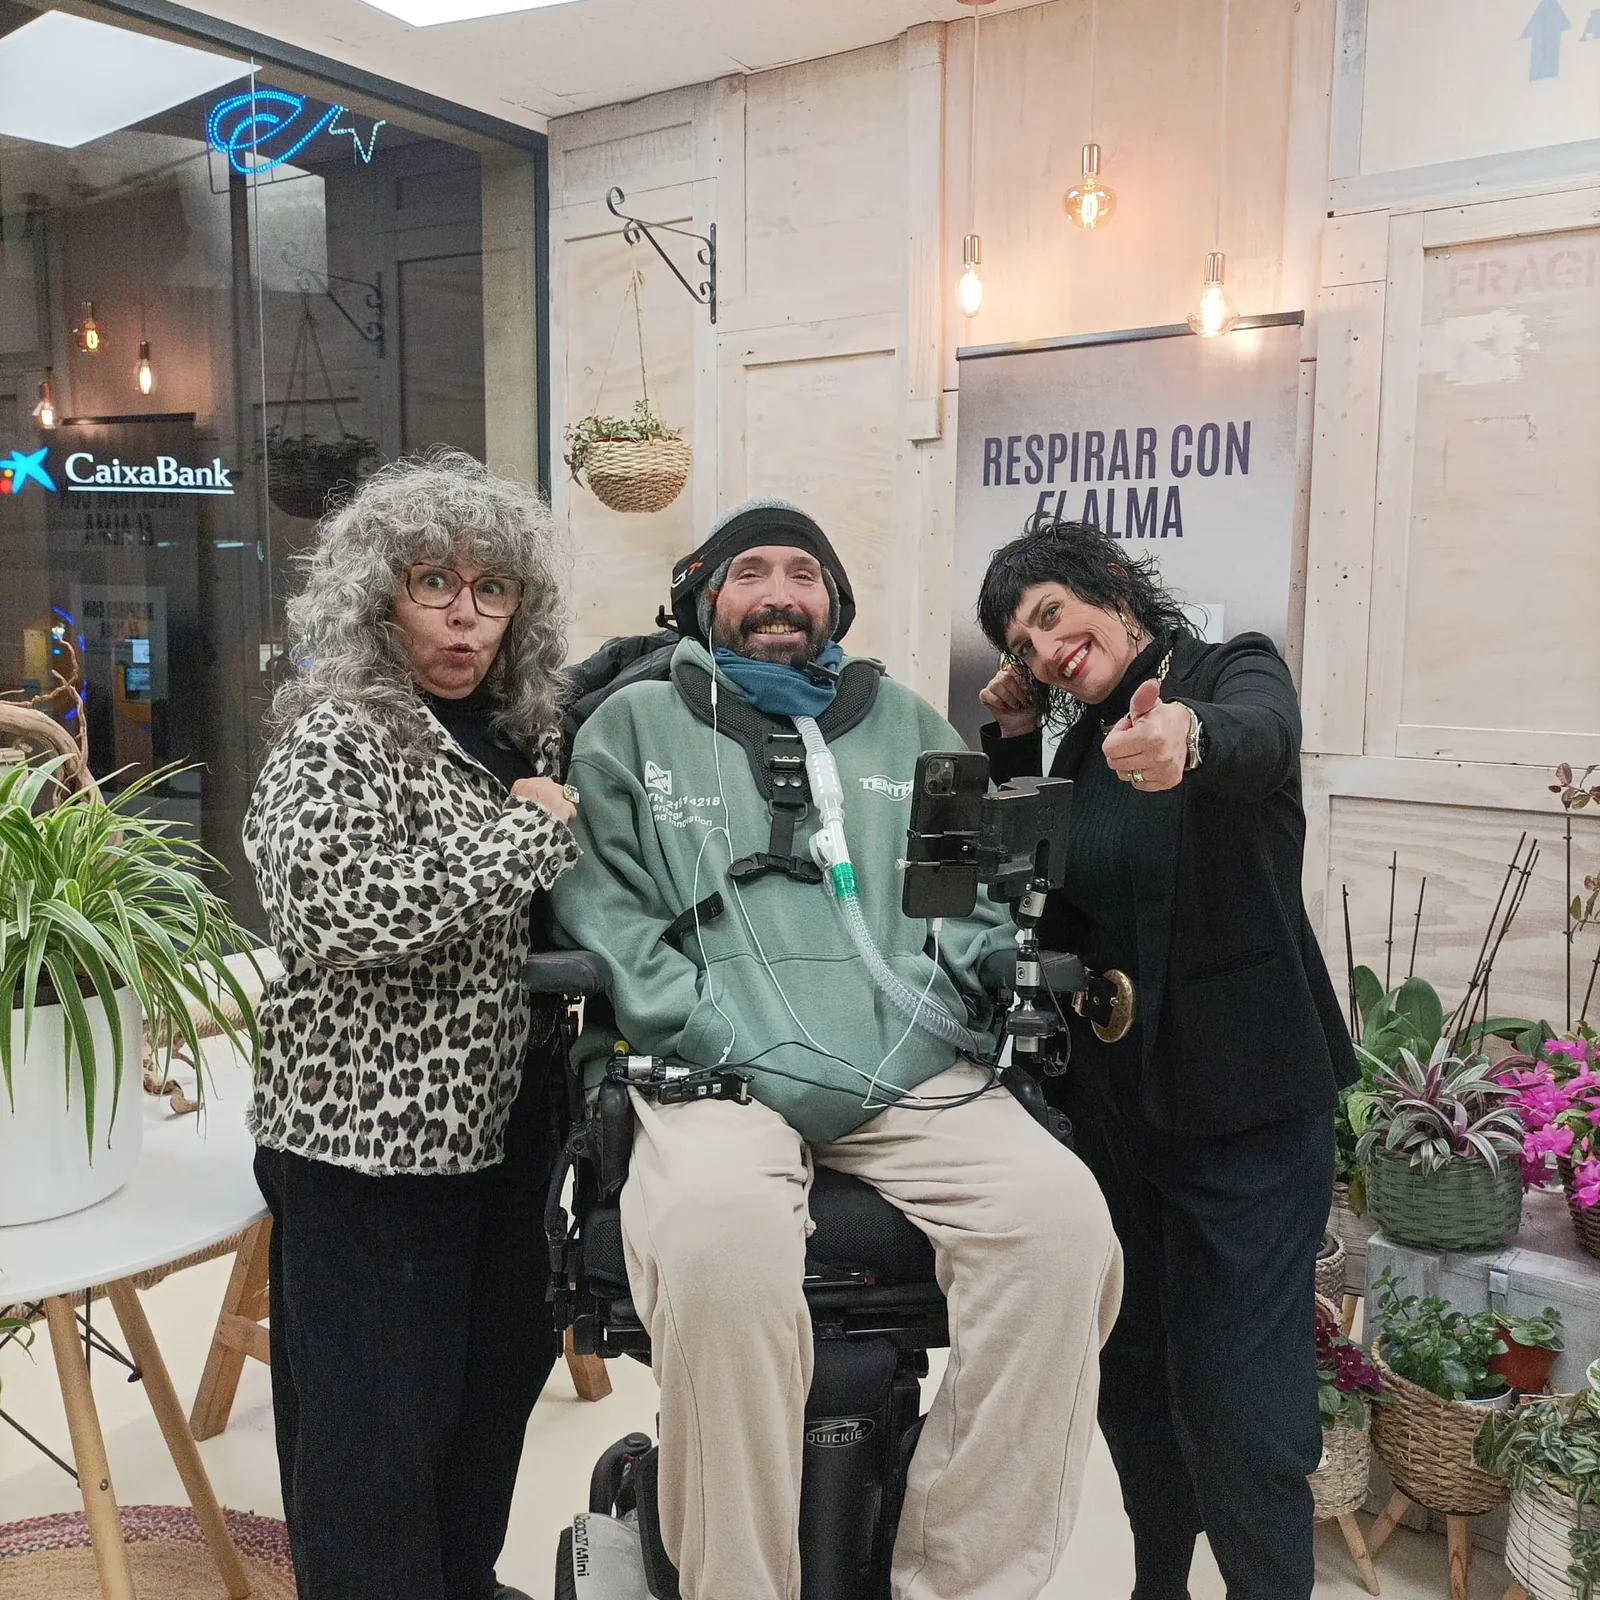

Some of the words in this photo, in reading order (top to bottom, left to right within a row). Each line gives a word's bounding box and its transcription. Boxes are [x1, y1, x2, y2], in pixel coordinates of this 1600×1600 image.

[1448, 250, 1600, 297] FRAGI
[65, 453, 233, 487] CaixaBank
[983, 427, 1157, 486] RESPIRAR
[1170, 420, 1251, 478] CON
[1082, 486, 1184, 538] ALMA
[654, 813, 667, 821] nd
[806, 1429, 863, 1444] QUICKIE
[576, 1547, 590, 1577] Mini
